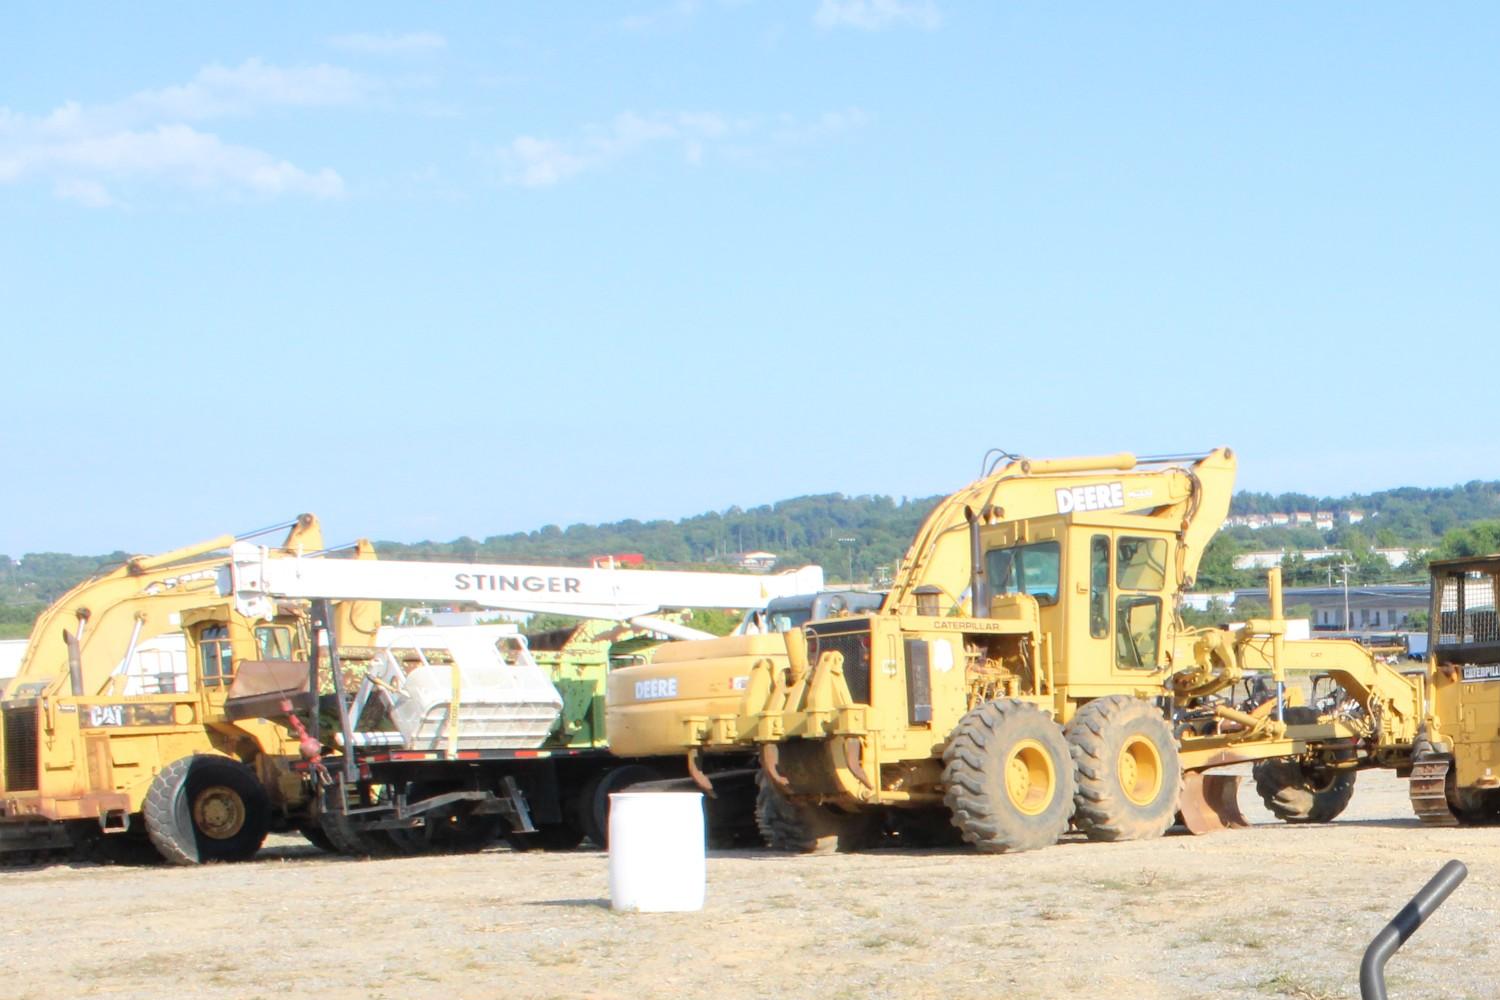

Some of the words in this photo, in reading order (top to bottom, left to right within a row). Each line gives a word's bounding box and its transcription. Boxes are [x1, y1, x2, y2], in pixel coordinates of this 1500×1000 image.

[1055, 482, 1124, 513] DEERE
[454, 573, 581, 593] STINGER
[934, 621, 1000, 630] CATERPILLAR
[635, 678, 677, 699] DEERE
[91, 704, 123, 727] CAT
